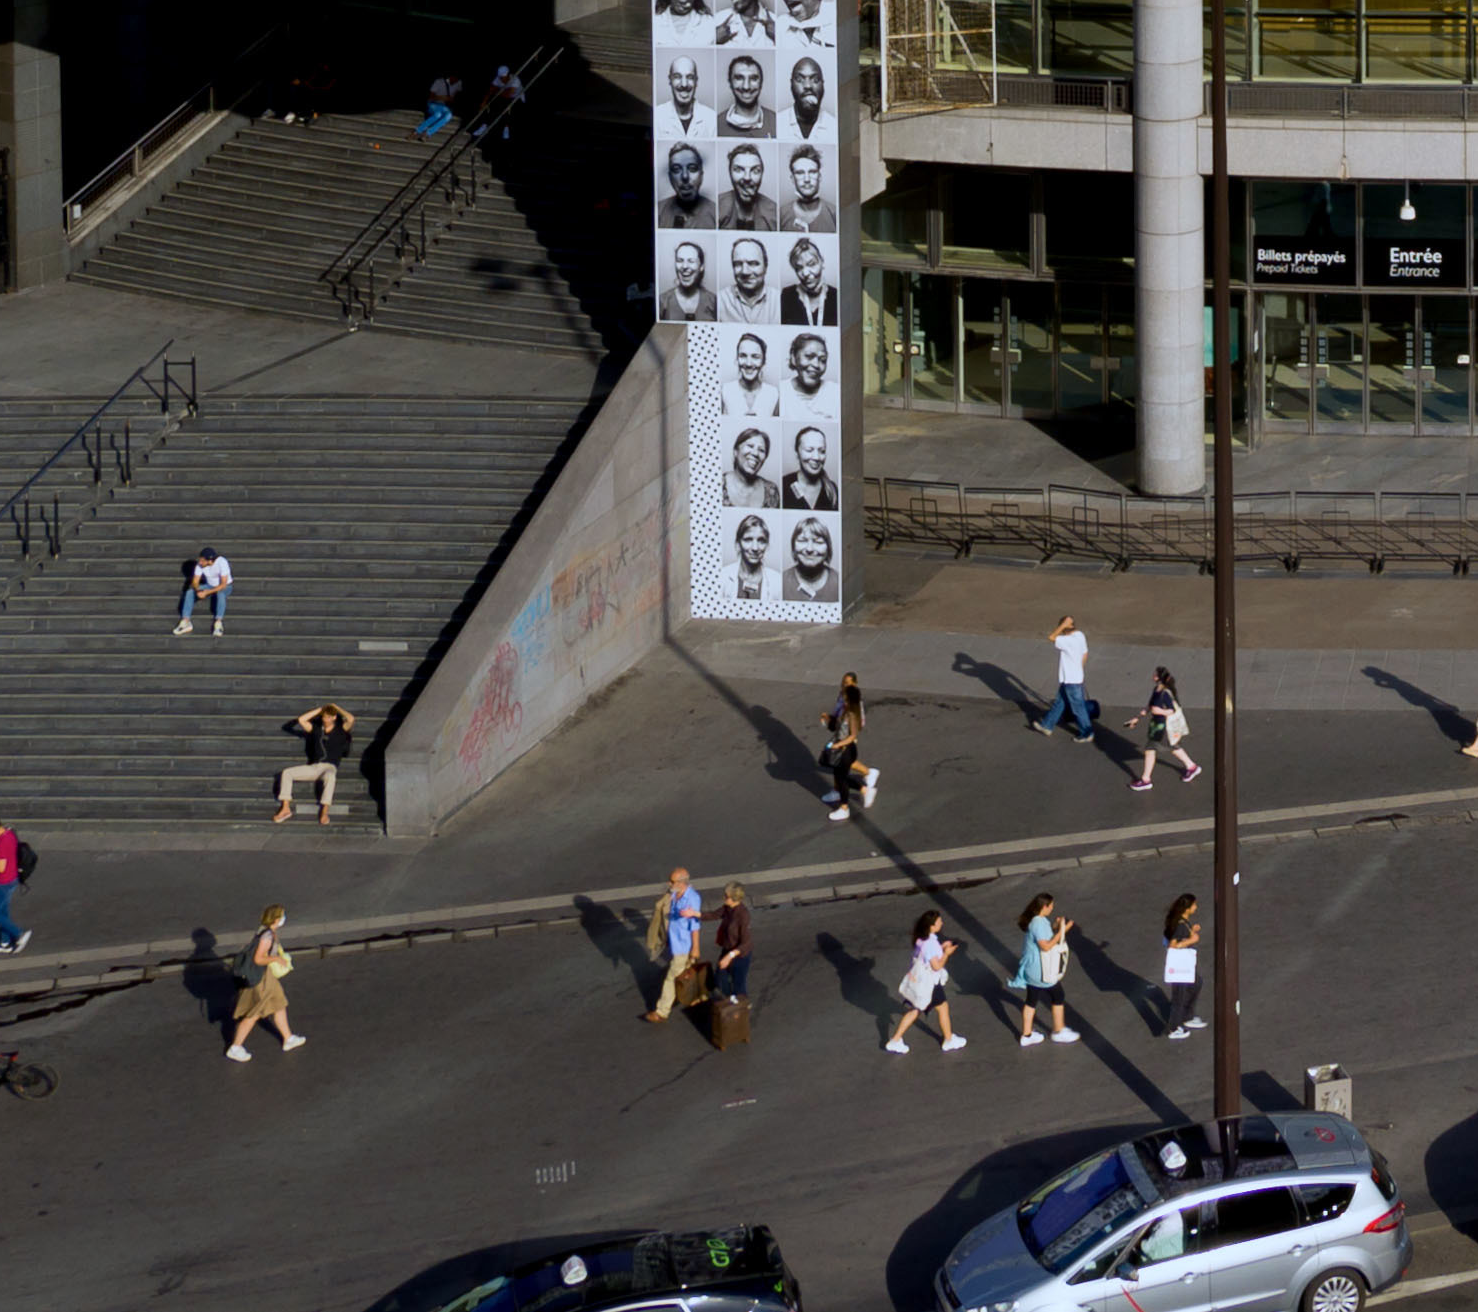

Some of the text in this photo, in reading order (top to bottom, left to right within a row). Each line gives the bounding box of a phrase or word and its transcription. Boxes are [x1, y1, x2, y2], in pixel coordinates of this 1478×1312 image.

[1257, 248, 1347, 266] Billets prépayés
[1389, 247, 1443, 264] Entrée
[1256, 262, 1319, 275] Prepaid Tickets
[1389, 264, 1440, 278] Entrance
